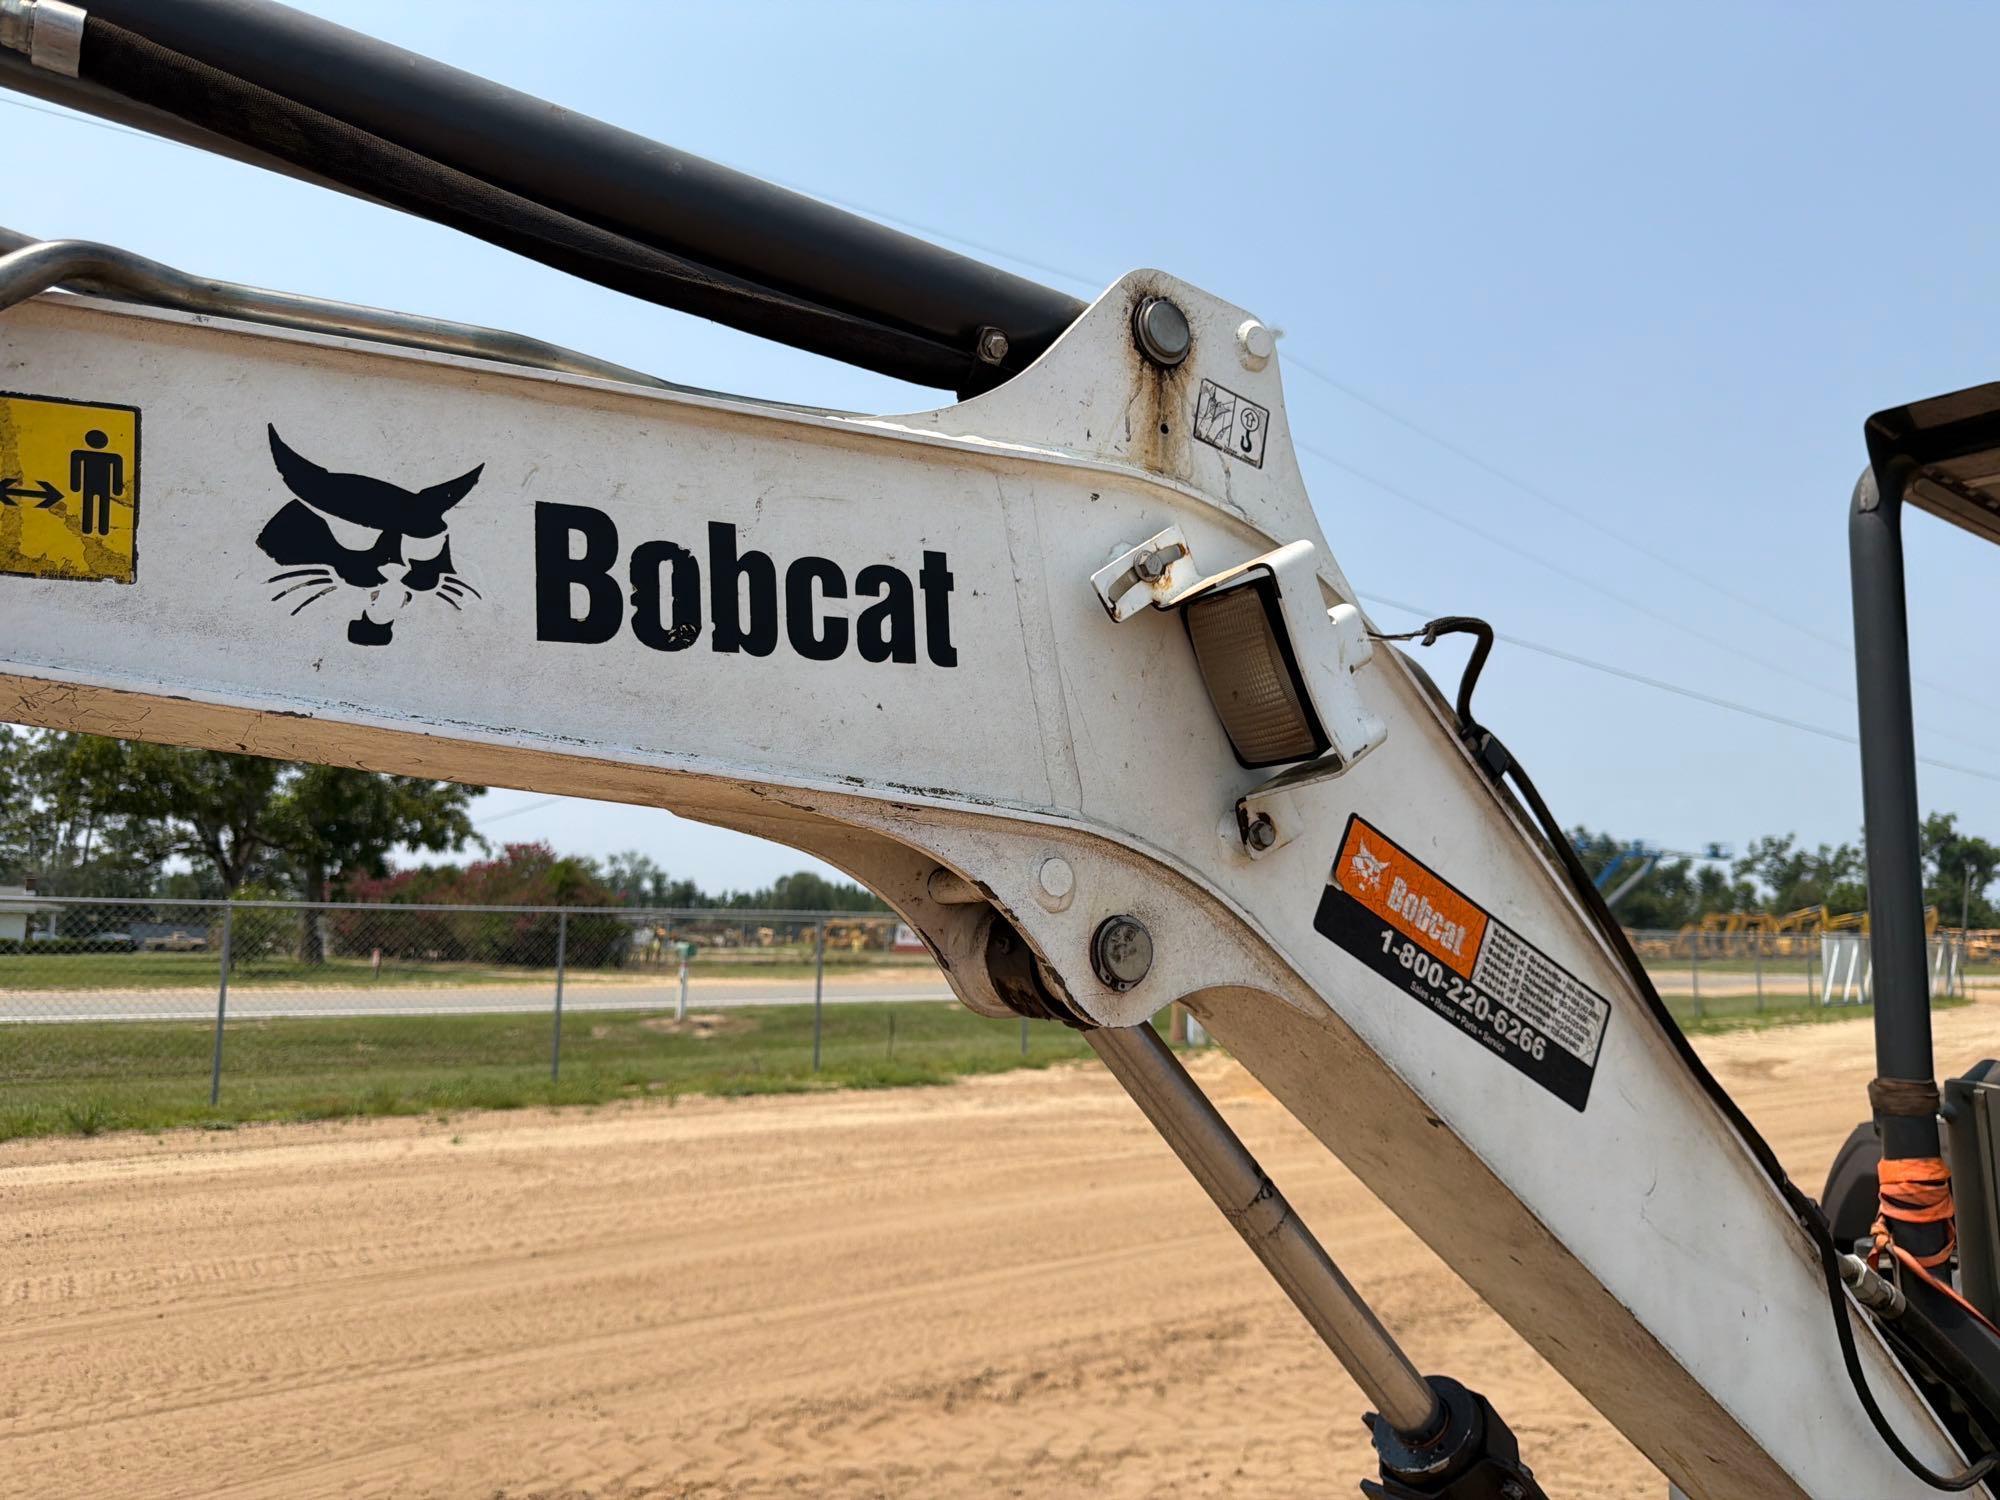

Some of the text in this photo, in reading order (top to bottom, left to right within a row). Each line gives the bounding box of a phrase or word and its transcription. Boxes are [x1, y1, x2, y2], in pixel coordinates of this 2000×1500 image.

[535, 501, 957, 667] Bobcat
[1386, 876, 1465, 956] Bobcat
[1380, 929, 1546, 1060] 1-800-220-6266
[1409, 980, 1505, 1052] Sales Rental Parts Service
